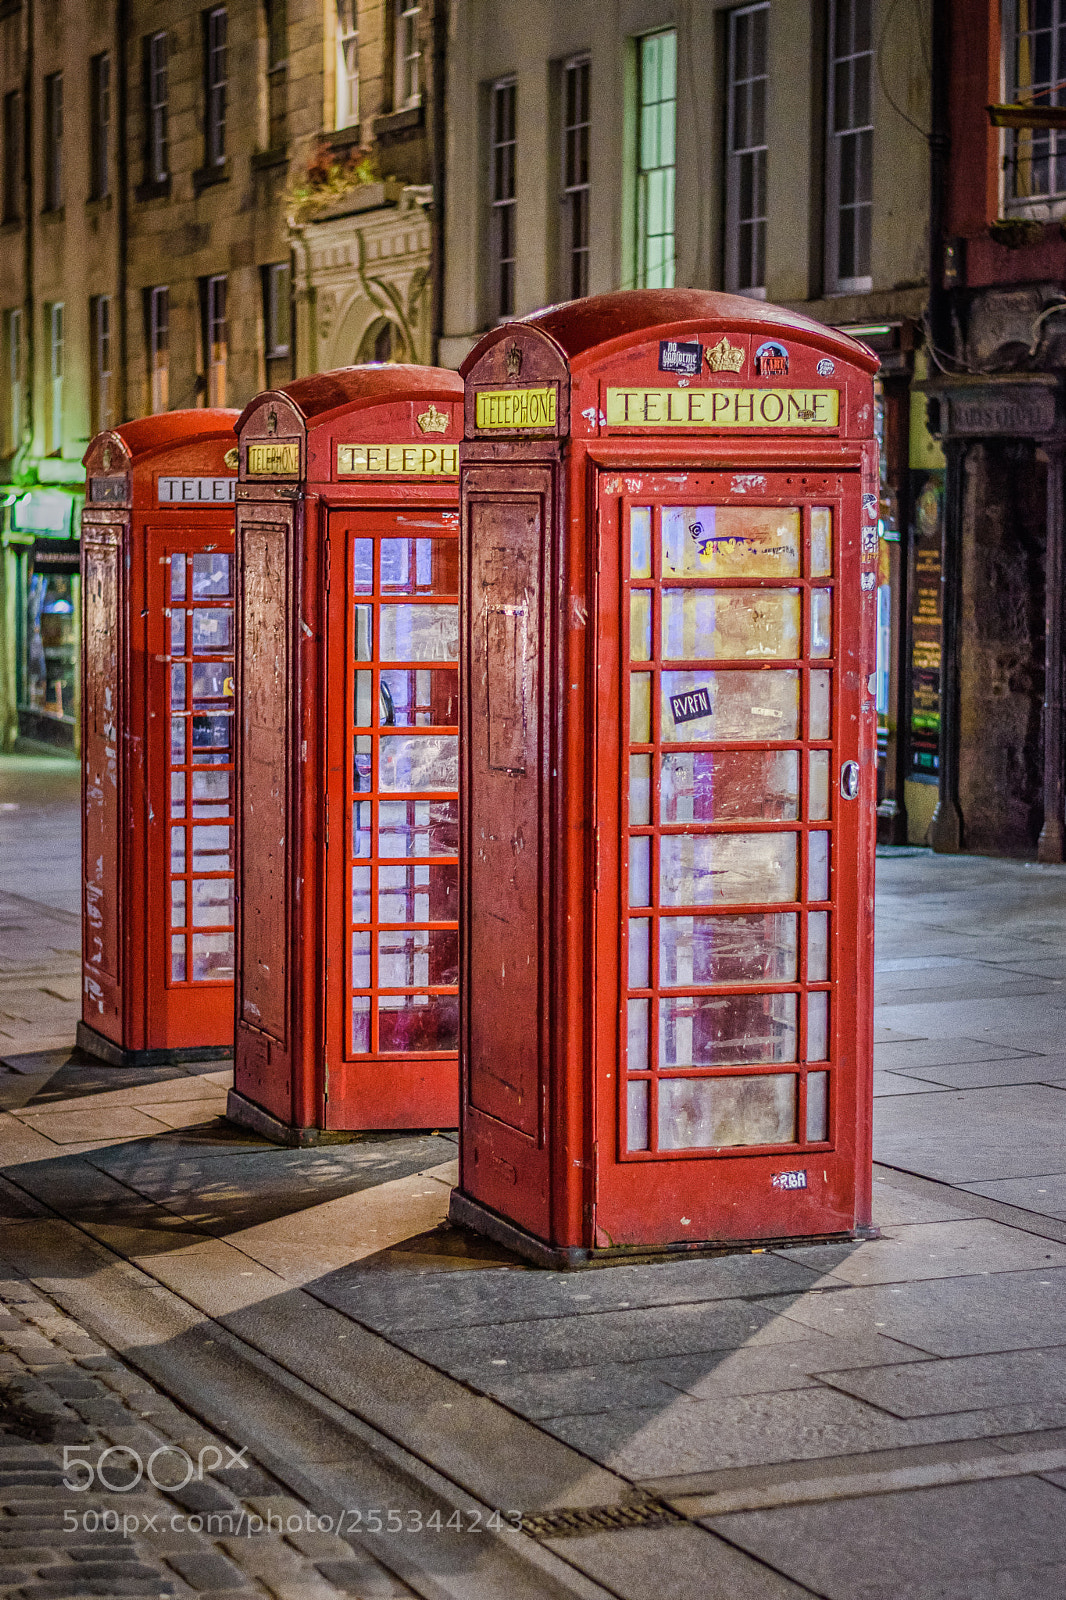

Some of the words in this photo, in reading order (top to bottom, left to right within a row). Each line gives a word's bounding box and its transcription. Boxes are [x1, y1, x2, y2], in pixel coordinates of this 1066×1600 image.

[481, 392, 556, 425] TELEPHONE
[616, 393, 829, 422] TELEPHONE
[251, 447, 299, 474] TELEPHONE
[344, 447, 459, 472] TELEPH
